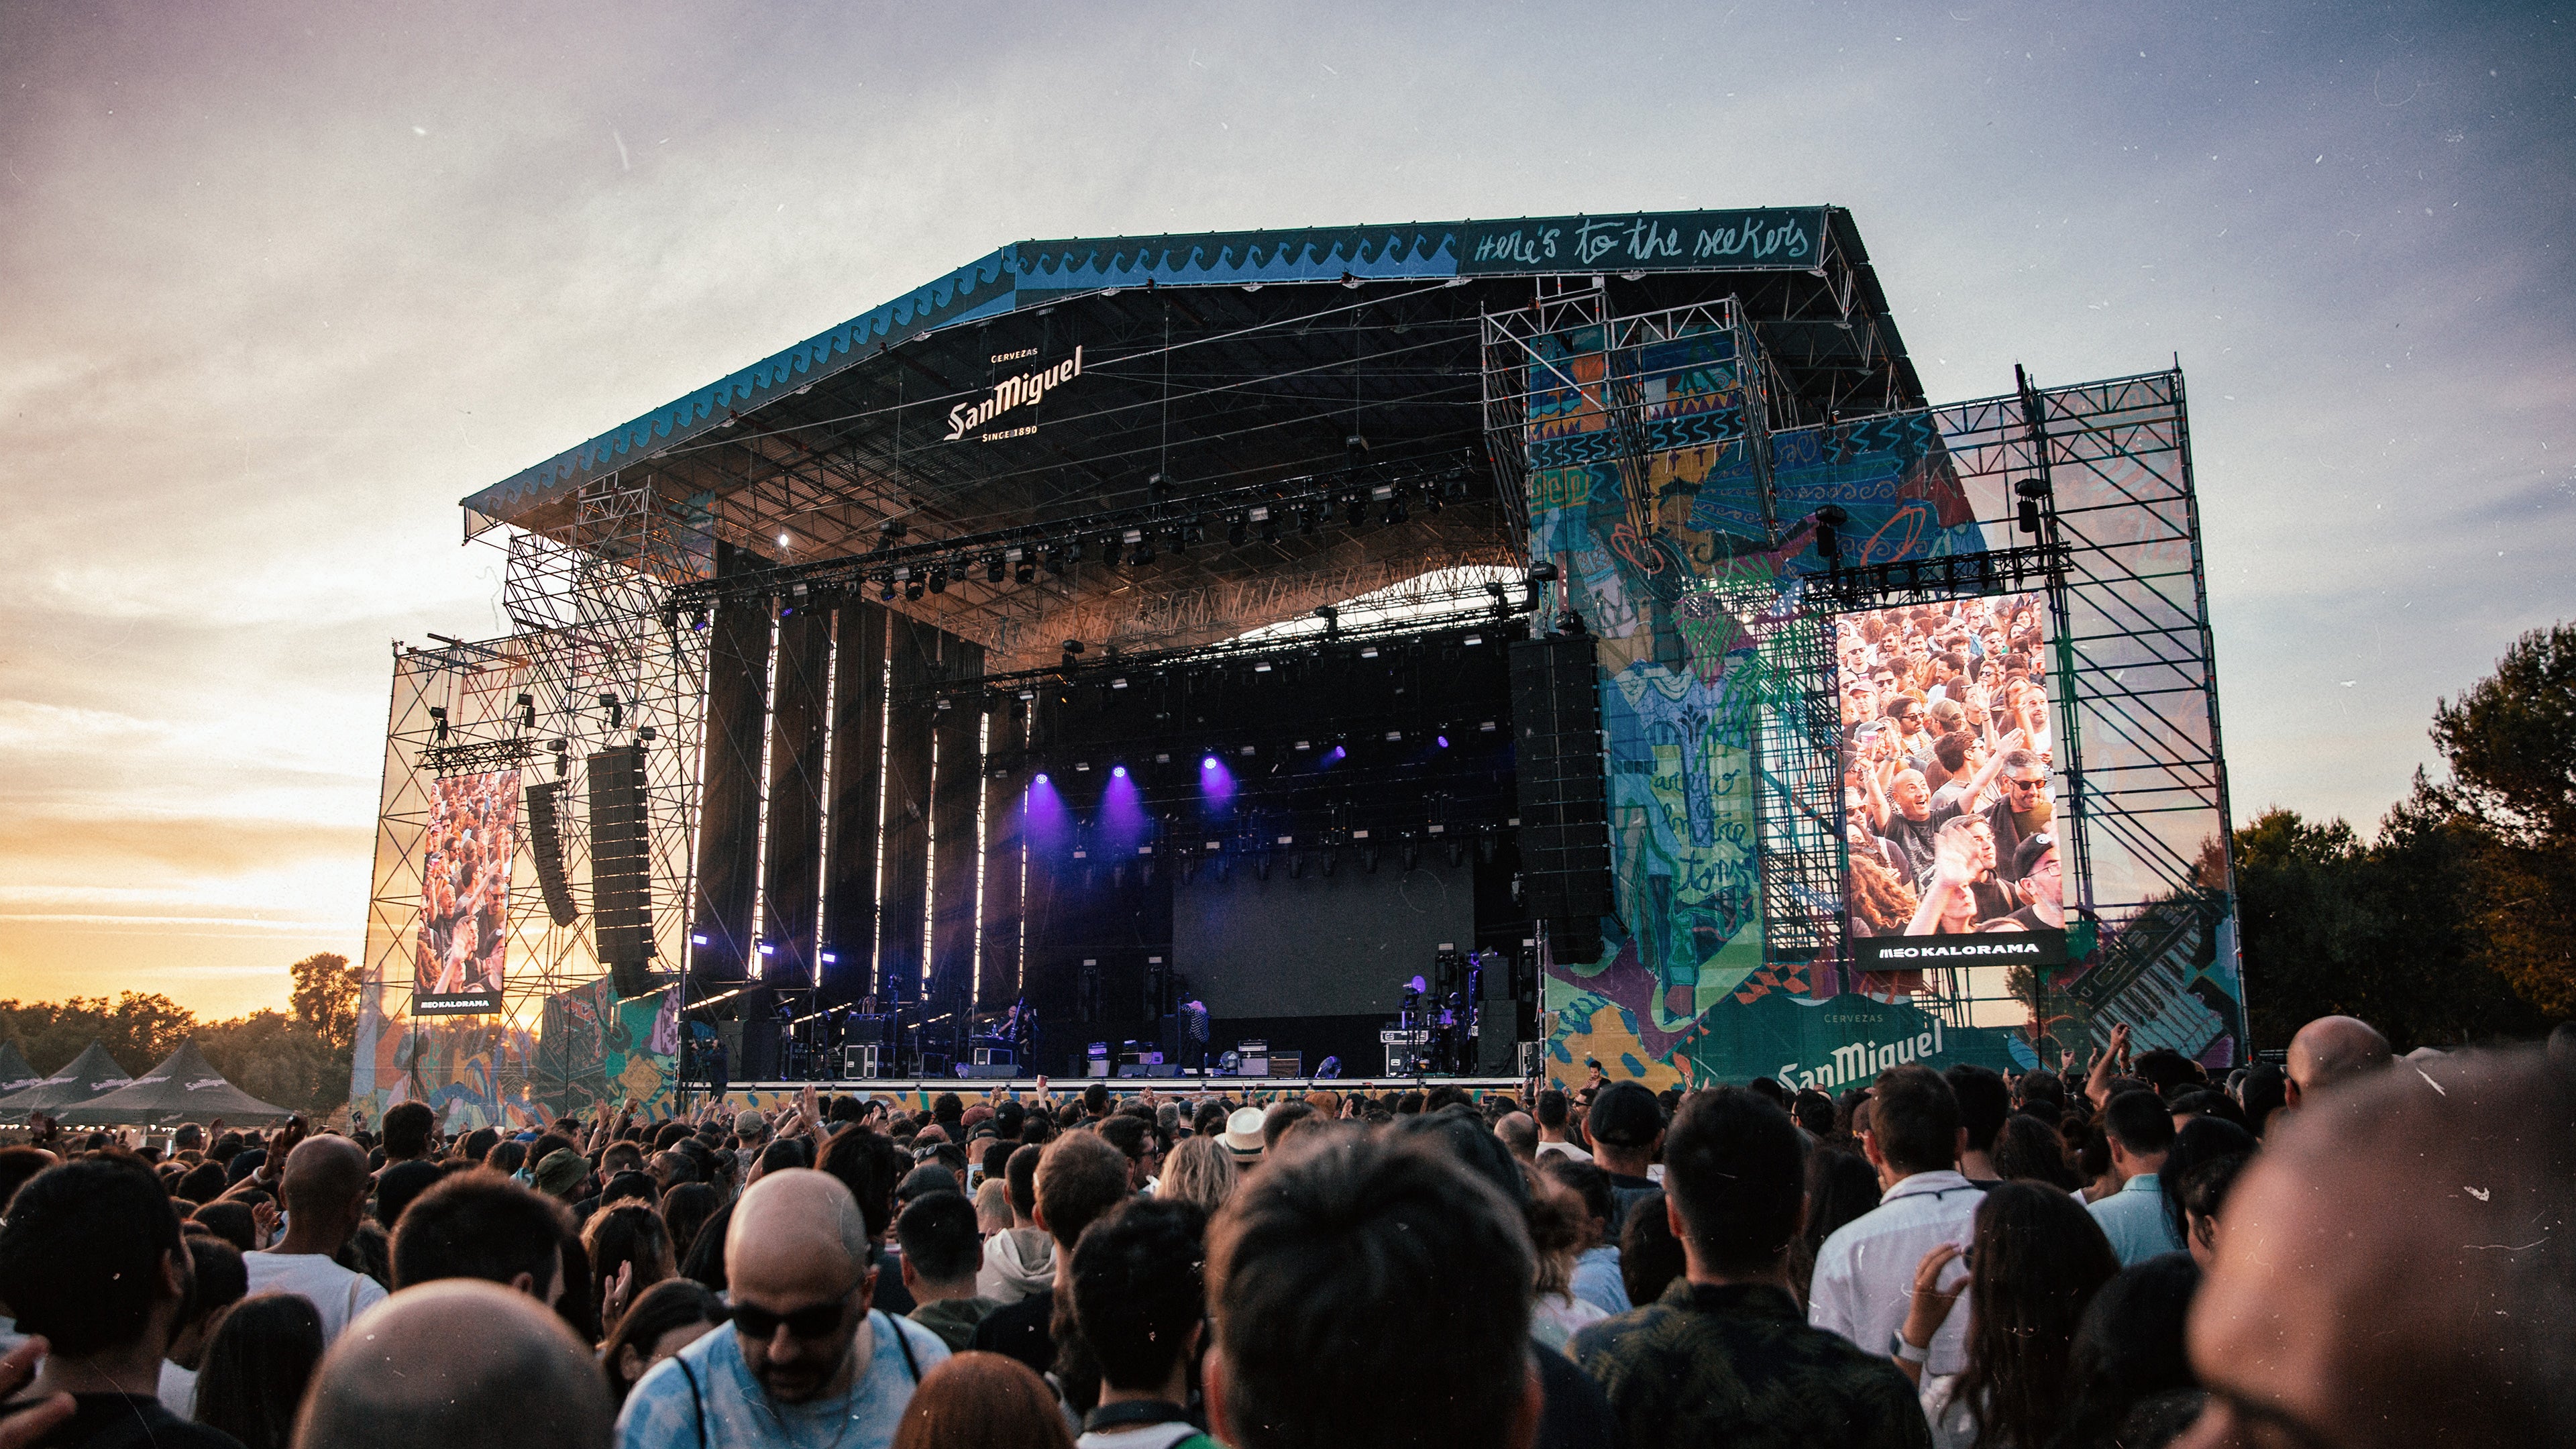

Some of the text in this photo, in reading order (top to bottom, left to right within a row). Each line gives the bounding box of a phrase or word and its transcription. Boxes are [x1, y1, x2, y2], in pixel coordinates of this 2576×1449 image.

[1475, 217, 1809, 264] Here's to the seekers
[991, 347, 1038, 364] CERVEZAS
[982, 425, 1038, 442] SINCE 1890
[1879, 943, 2040, 959] MEO KALORAMA
[439, 1000, 490, 1008] KALORAMA
[1824, 1014, 1884, 1023] CERVEZAS
